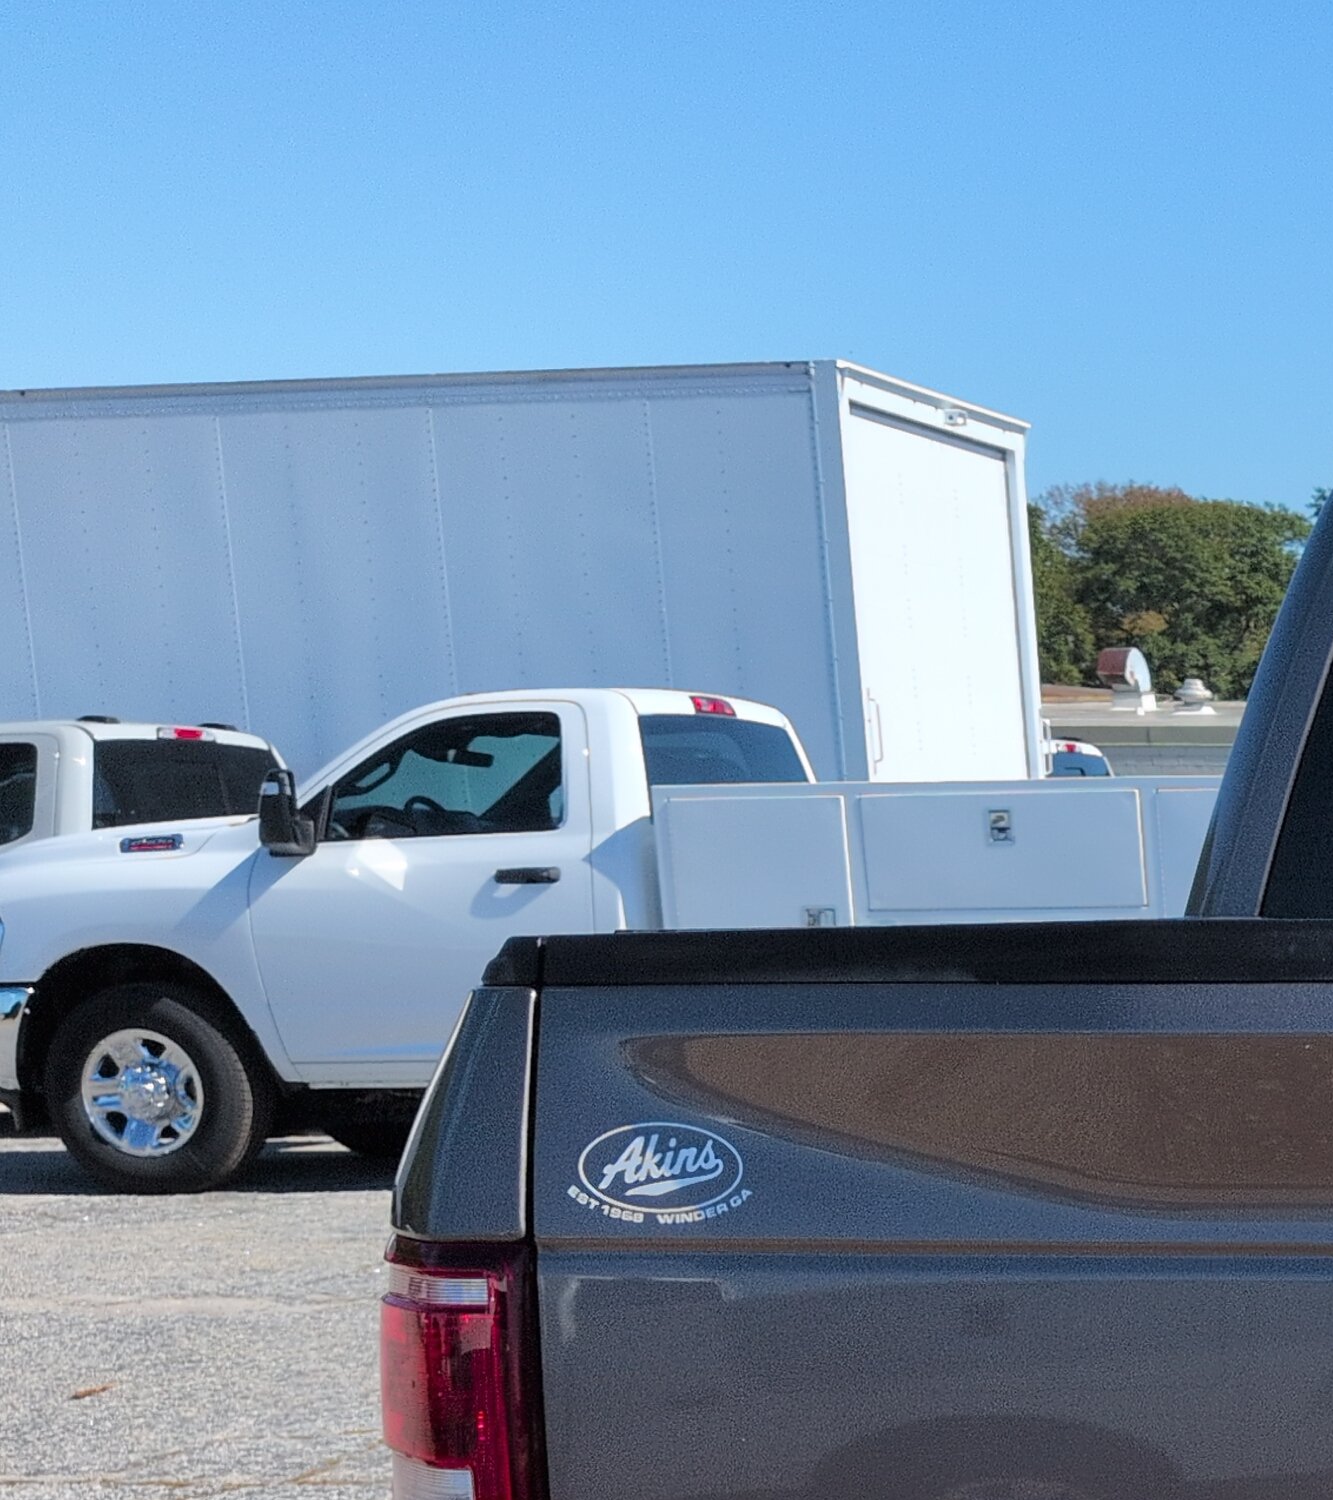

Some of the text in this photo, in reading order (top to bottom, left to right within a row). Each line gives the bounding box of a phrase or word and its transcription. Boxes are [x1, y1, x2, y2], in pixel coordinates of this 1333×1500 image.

[598, 1134, 724, 1197] Akins
[567, 1184, 600, 1210] EST
[656, 1202, 729, 1224] WINDER
[730, 1188, 753, 1208] GA
